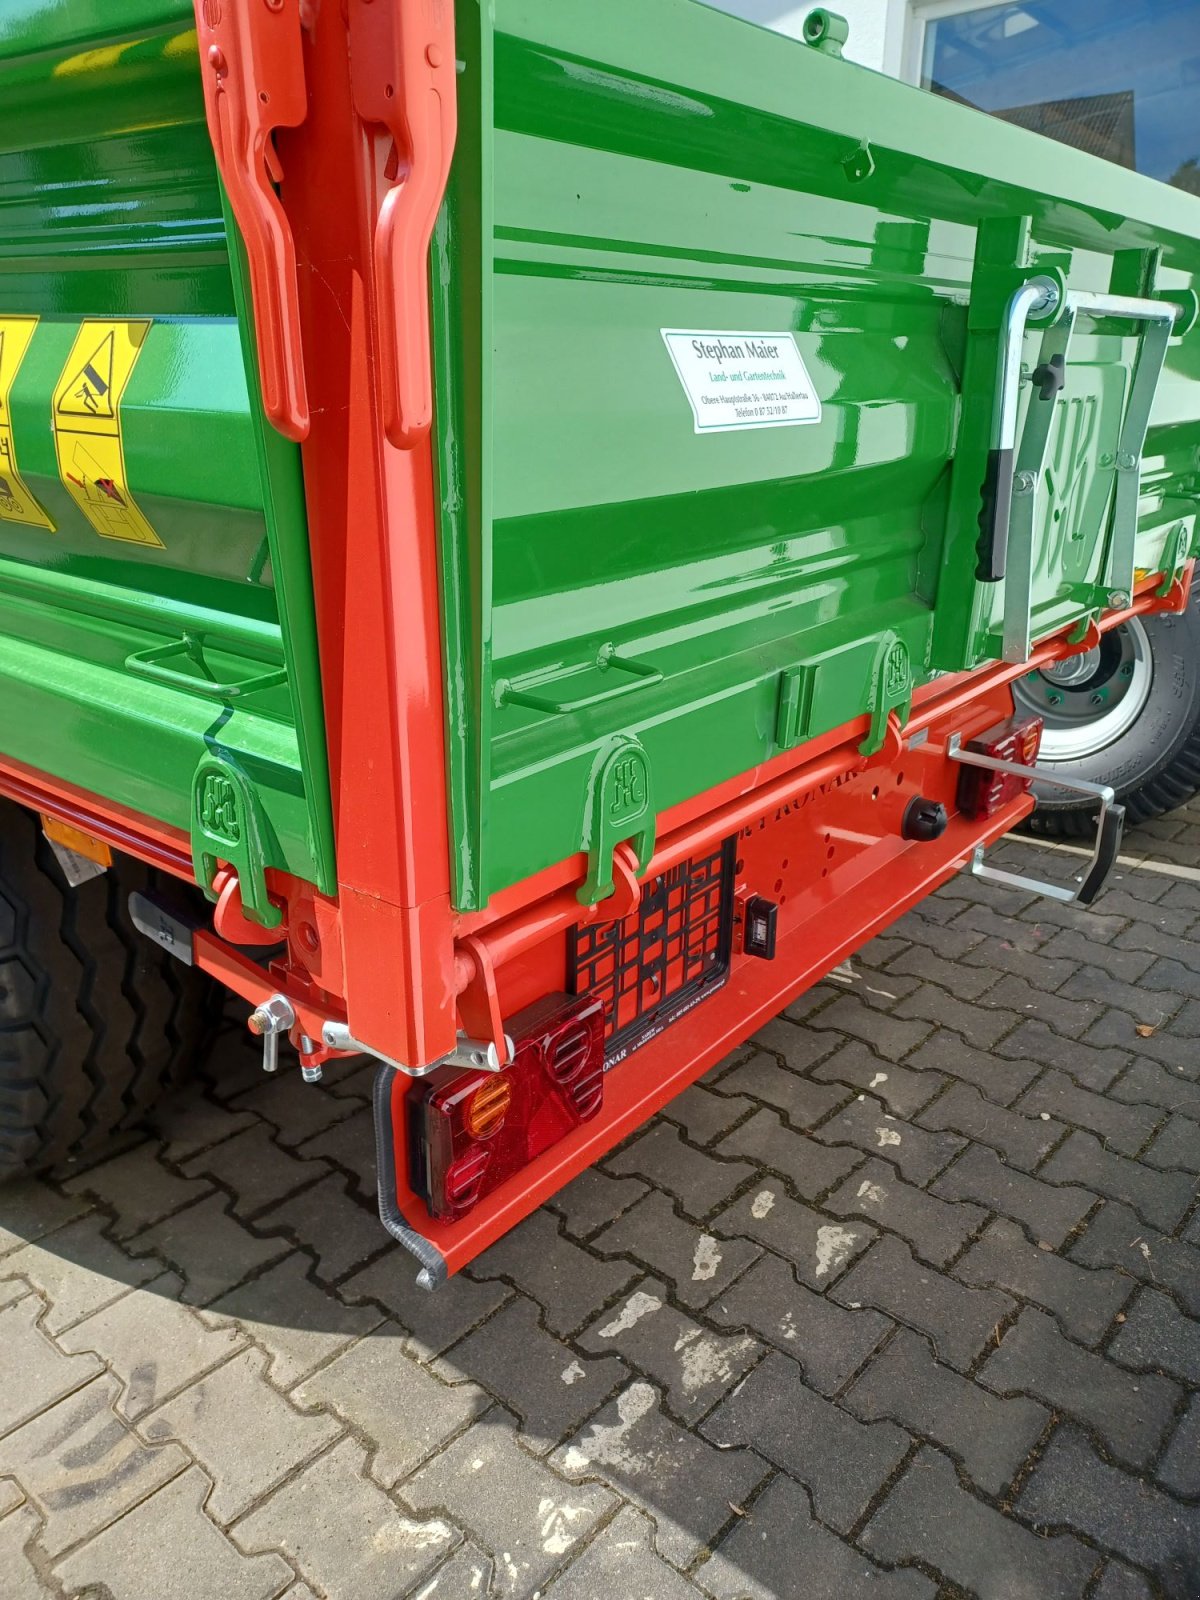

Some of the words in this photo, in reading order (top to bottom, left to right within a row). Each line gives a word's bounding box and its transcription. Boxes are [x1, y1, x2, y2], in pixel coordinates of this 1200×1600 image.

[692, 339, 745, 365] Stephan
[744, 339, 779, 359] Maier
[709, 370, 728, 382] Land-
[730, 370, 743, 381] und
[743, 369, 786, 381] Gartentechnik
[700, 395, 720, 404] Obere
[719, 393, 752, 406] Hauptstraße
[734, 407, 754, 417] Telefon
[602, 1049, 626, 1072] ONAR
